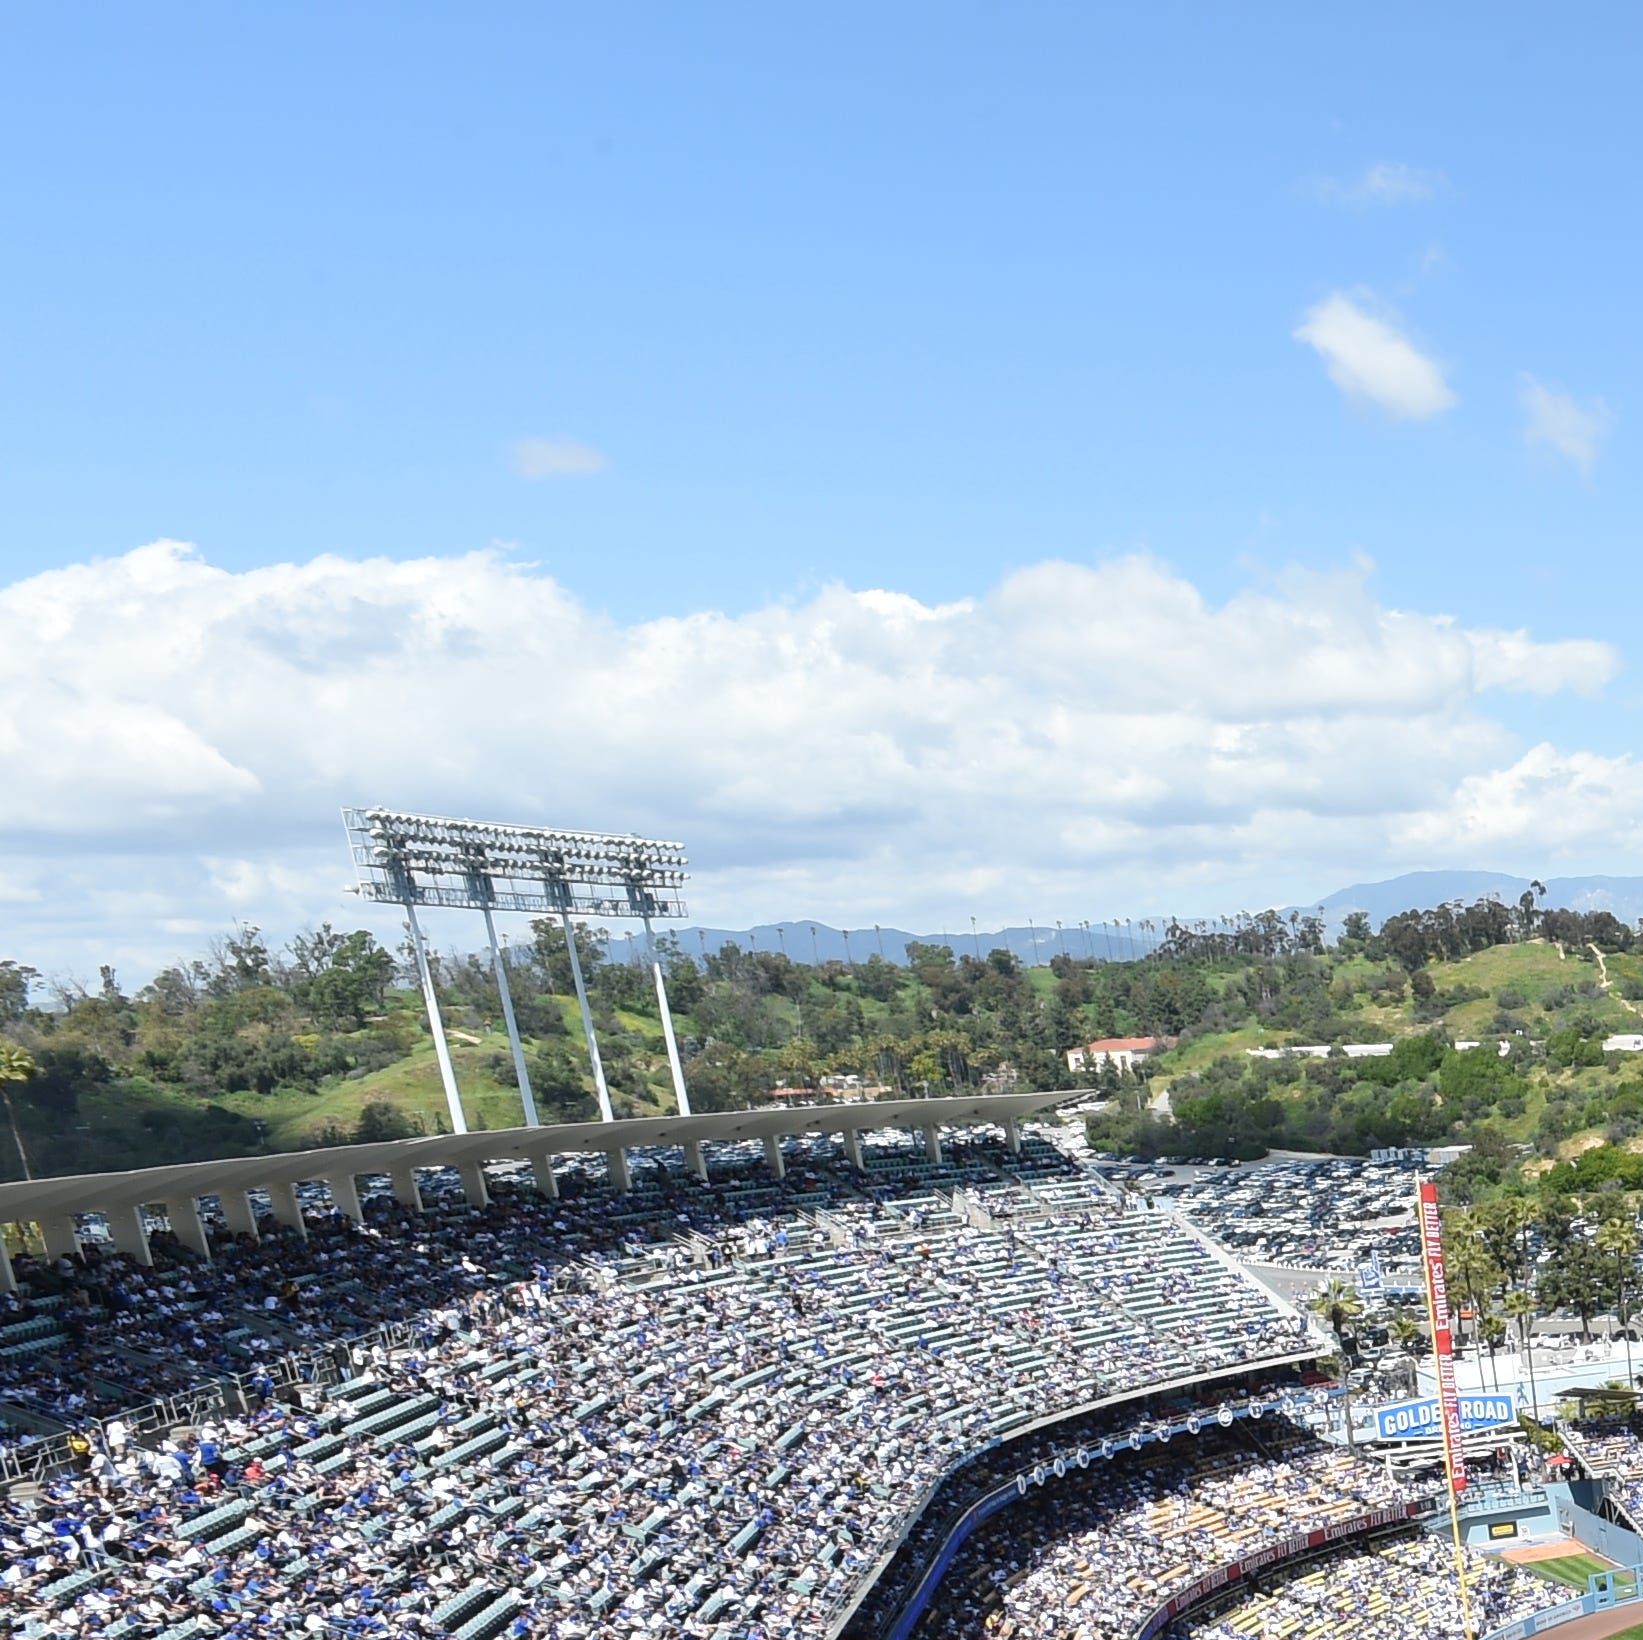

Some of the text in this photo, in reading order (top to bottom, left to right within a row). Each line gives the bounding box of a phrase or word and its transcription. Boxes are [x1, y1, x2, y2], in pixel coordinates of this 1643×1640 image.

[1422, 1201, 1449, 1332] Emirates FLY BETTER
[1384, 1402, 1509, 1436] GOLDE ROAD
[1438, 1354, 1465, 1480] Emirates FLY BETTER
[1324, 1518, 1369, 1541] Emirates
[1370, 1513, 1382, 1528] FLY
[1382, 1506, 1408, 1524] BETTER
[1239, 1535, 1310, 1574] Emirates FLY BETTER
